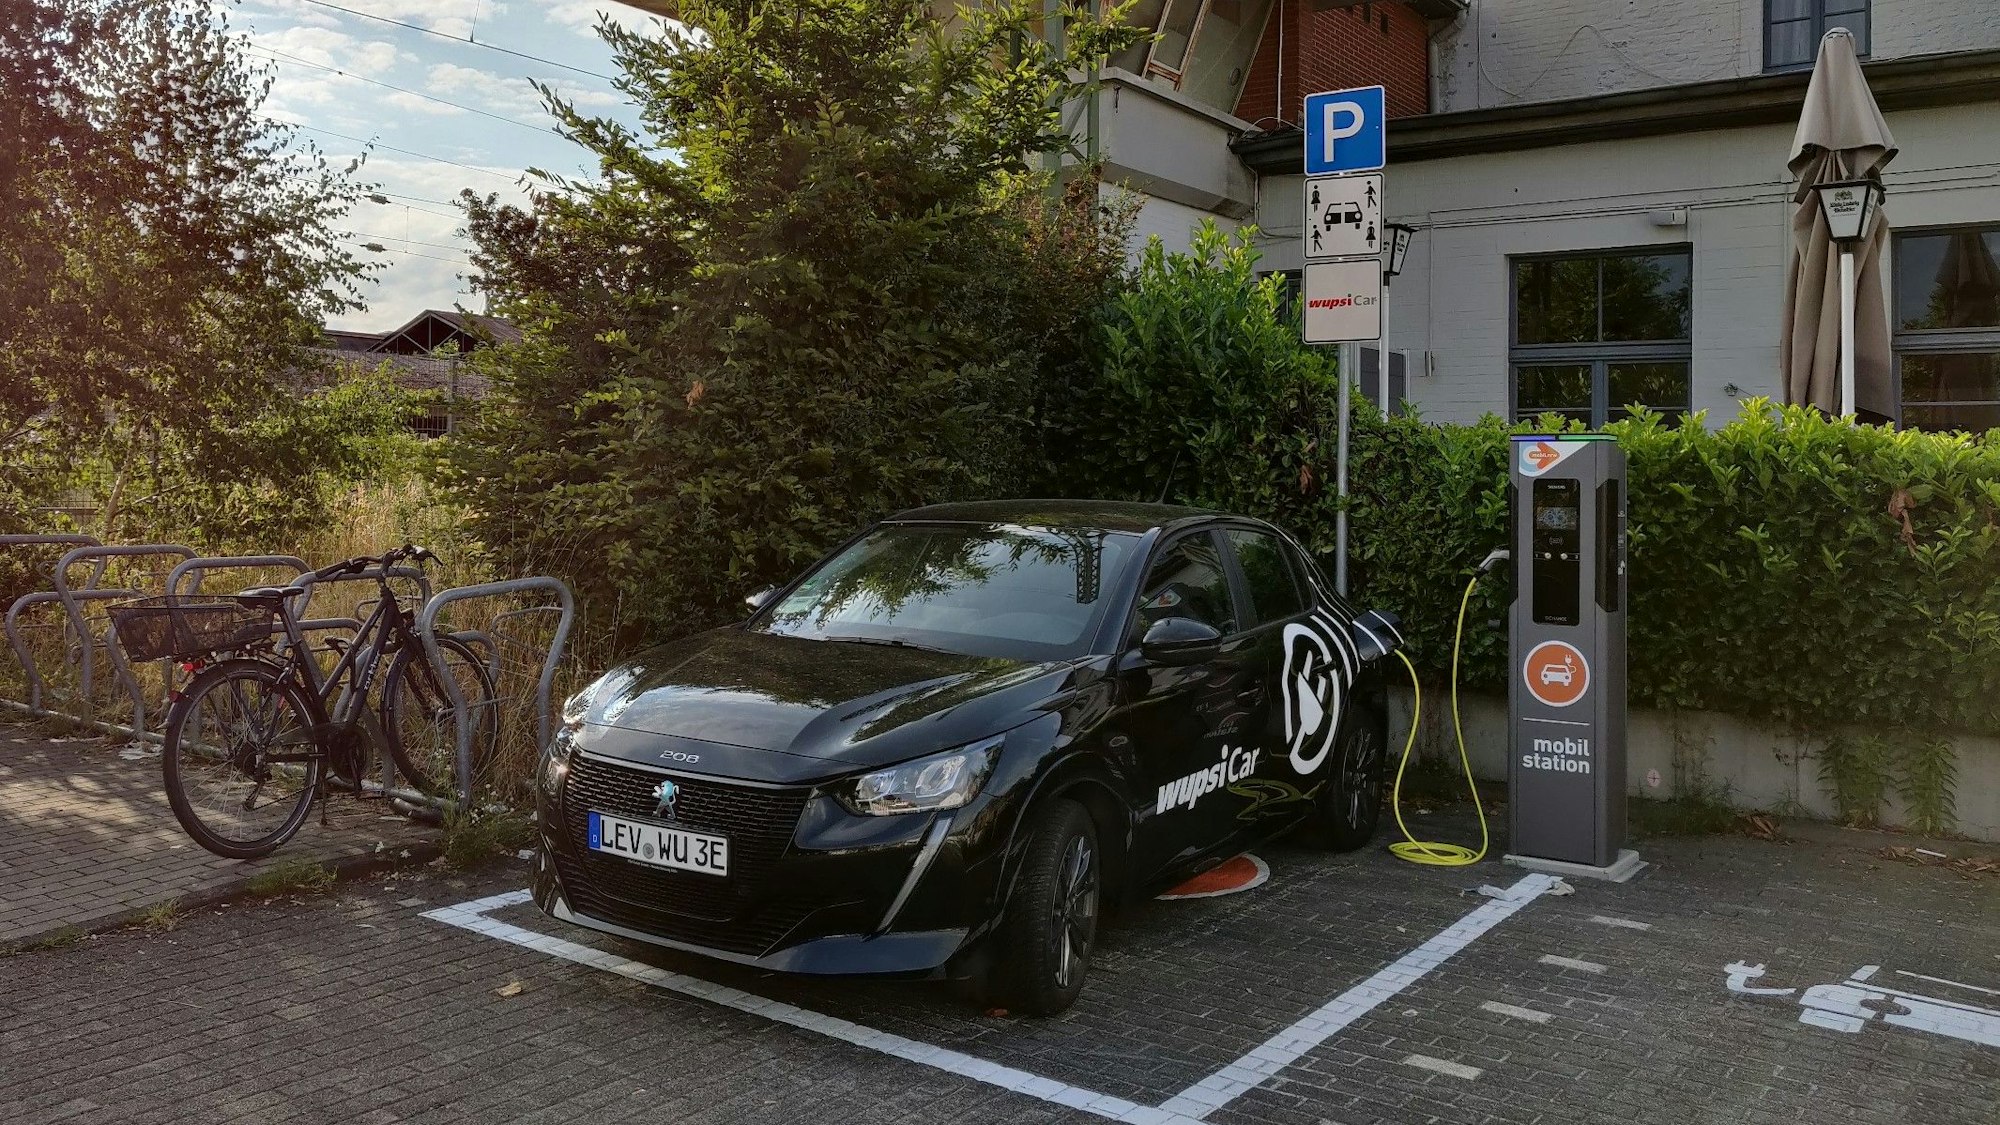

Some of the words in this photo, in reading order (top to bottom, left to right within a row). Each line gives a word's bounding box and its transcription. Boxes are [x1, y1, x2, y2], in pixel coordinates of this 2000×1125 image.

[1323, 101, 1365, 162] P
[660, 750, 699, 763] 208
[1534, 737, 1589, 756] mobil
[1522, 753, 1589, 773] station
[1156, 745, 1260, 815] wupsiCar
[592, 834, 598, 843] D
[601, 820, 641, 854] LEV
[658, 832, 688, 863] WU
[694, 838, 725, 870] 3E
